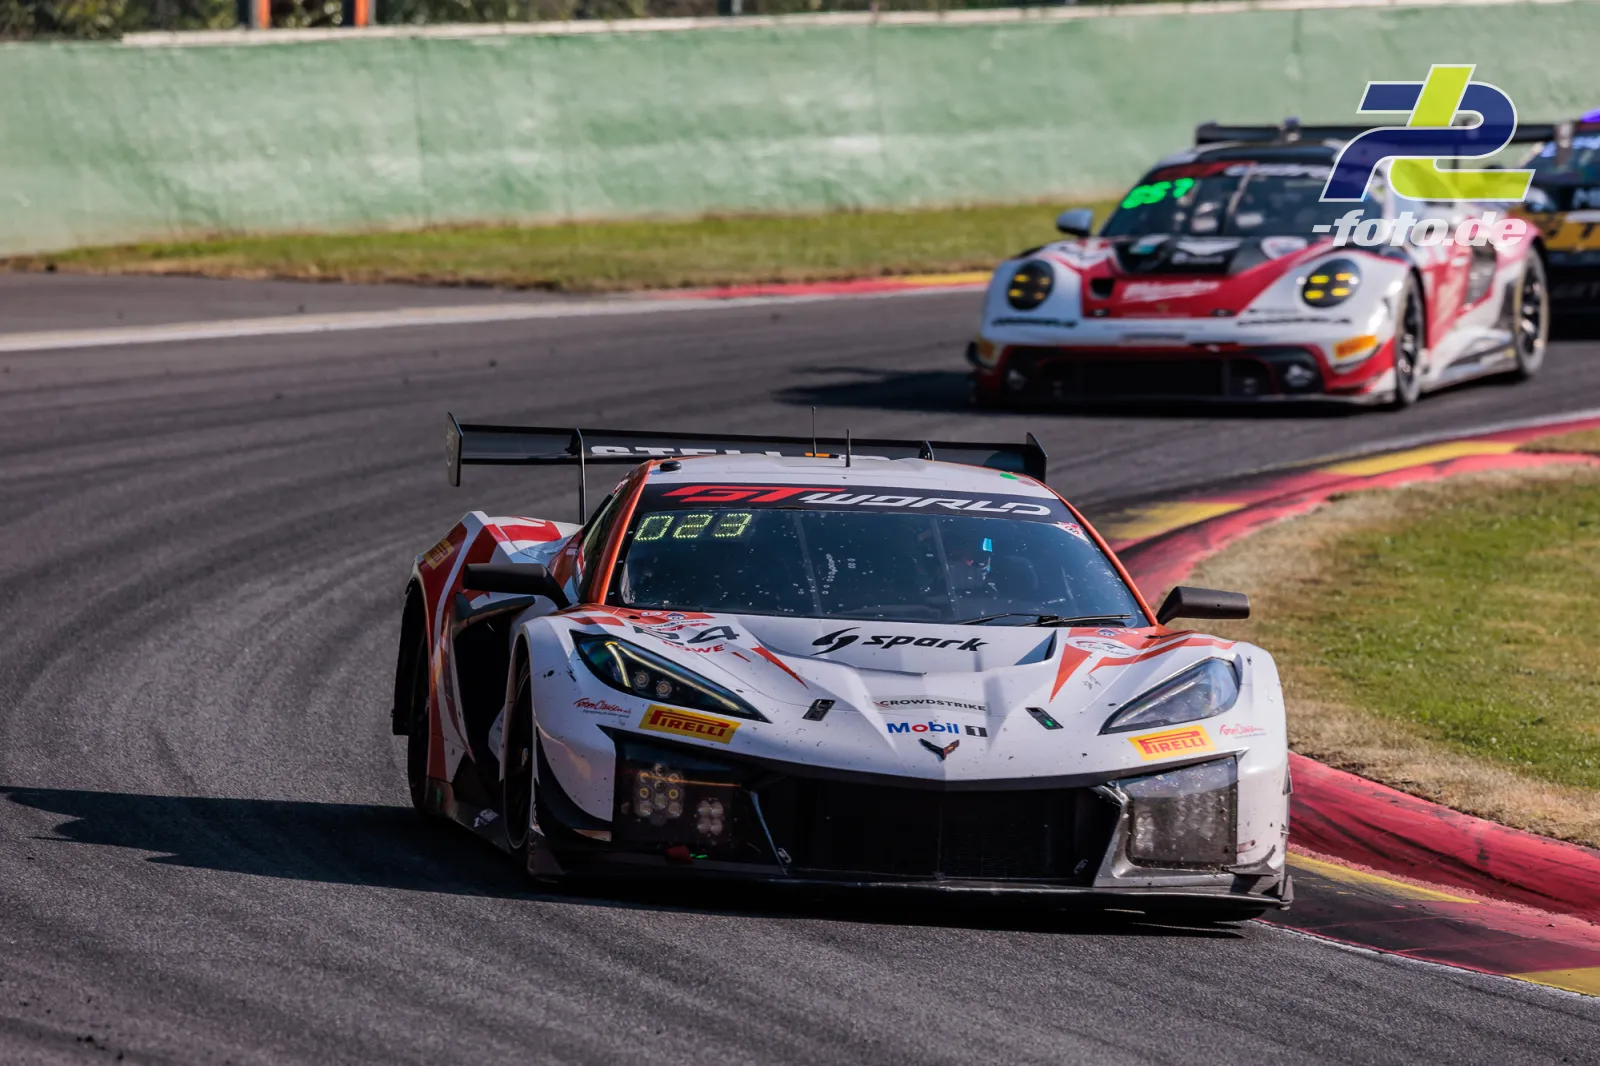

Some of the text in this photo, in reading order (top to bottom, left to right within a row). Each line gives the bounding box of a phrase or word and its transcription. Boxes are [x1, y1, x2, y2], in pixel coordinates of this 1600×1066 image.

[633, 513, 753, 541] 023
[861, 634, 990, 652] spark
[879, 698, 988, 712] CROWDSTRIKE
[648, 709, 731, 738] PIRELLI
[886, 721, 960, 734] Mobil
[1137, 730, 1208, 755] PIRELLI
